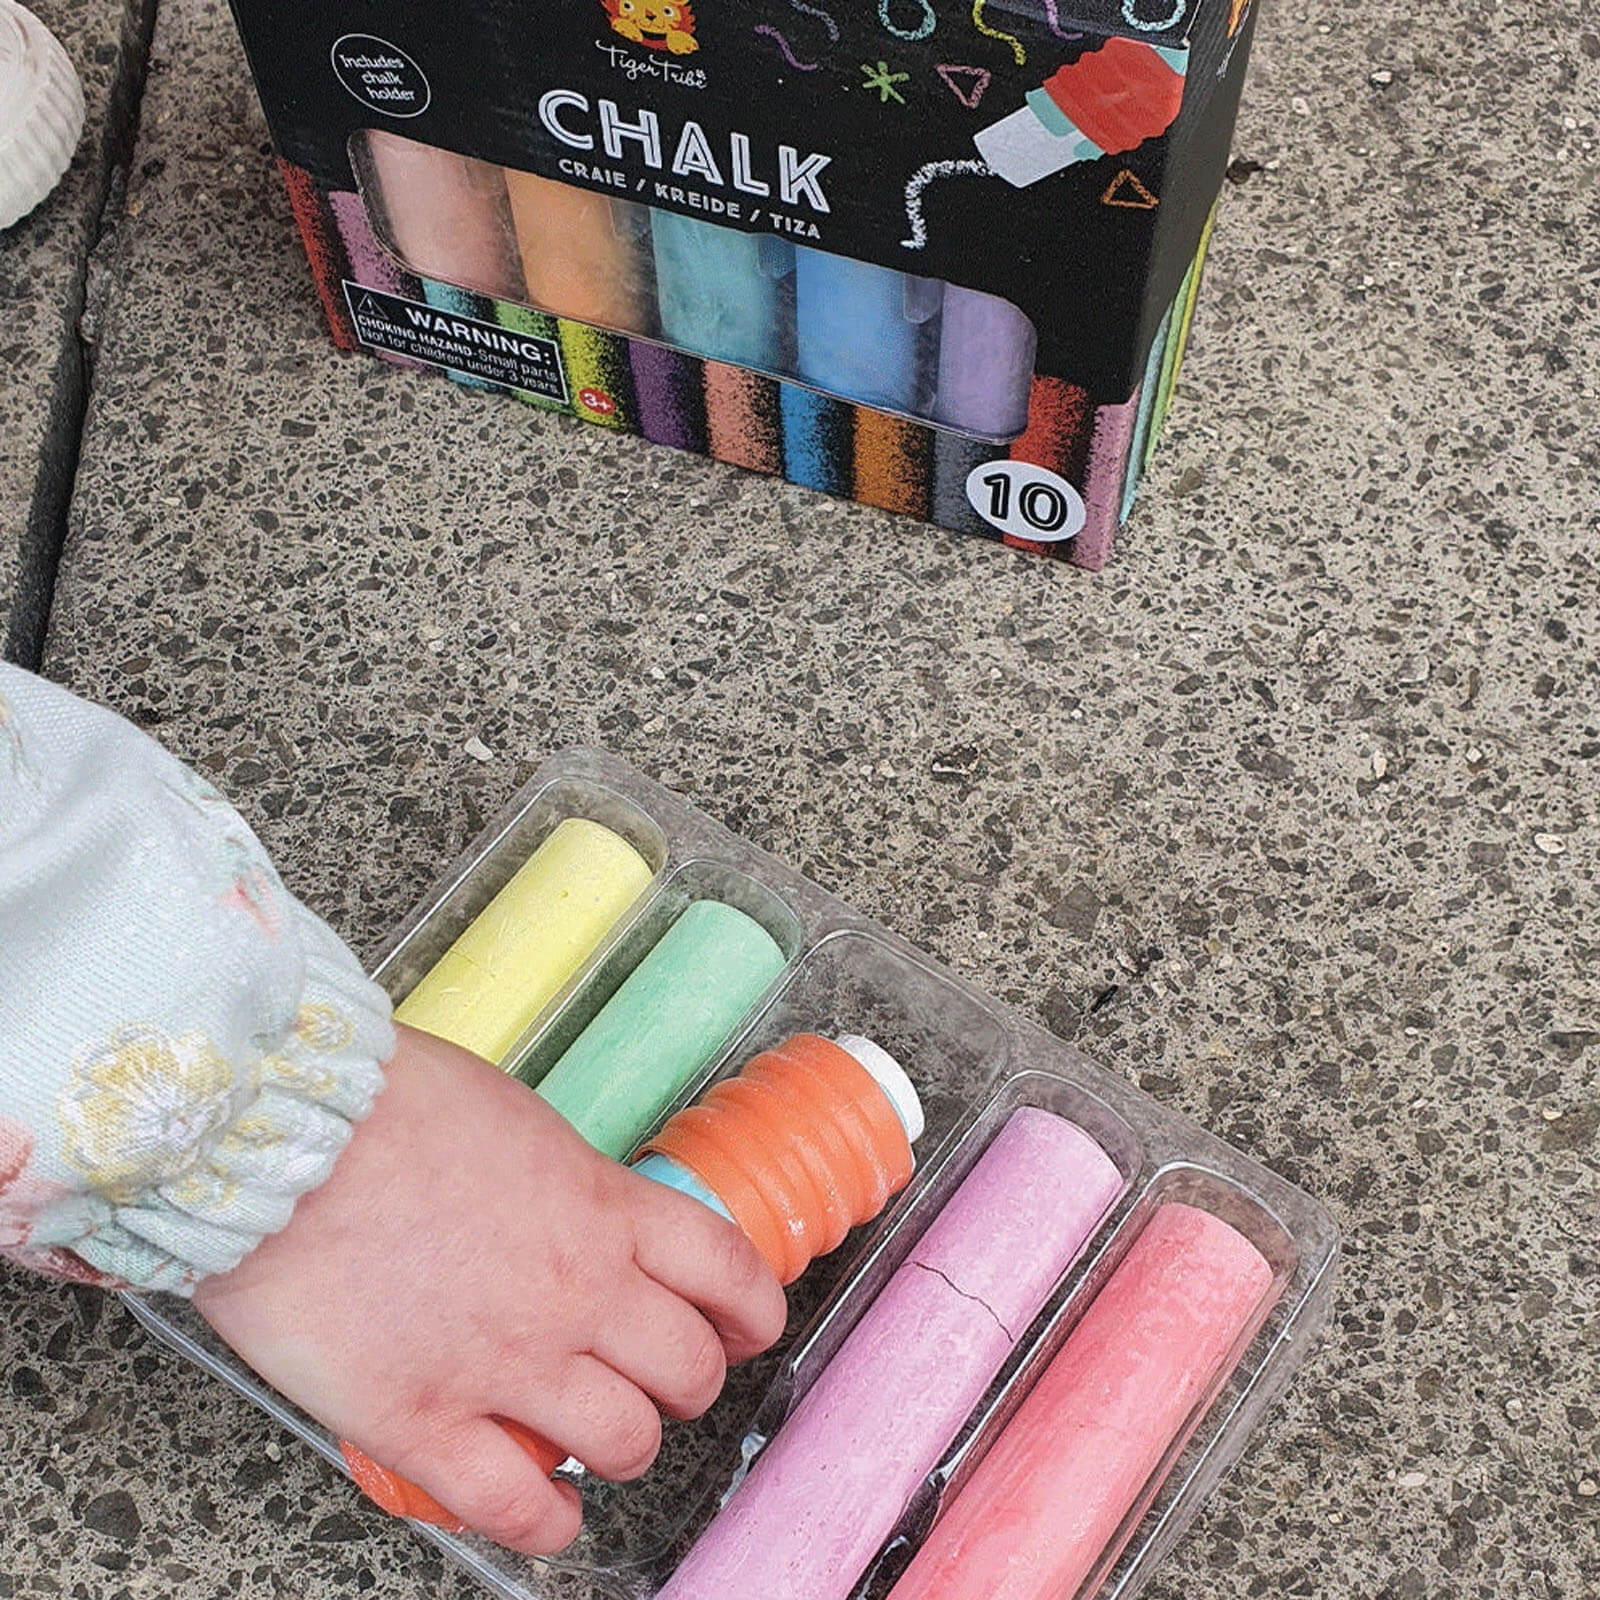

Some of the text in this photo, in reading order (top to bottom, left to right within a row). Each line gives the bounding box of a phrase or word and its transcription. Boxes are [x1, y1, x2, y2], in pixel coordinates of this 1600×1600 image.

[339, 54, 404, 69] Includes
[361, 70, 403, 85] chalk
[595, 40, 660, 80] Tiger
[366, 86, 415, 100] holder
[538, 90, 831, 213] CHALK
[558, 159, 627, 188] CRAIE
[655, 183, 741, 219] KREIDE
[769, 212, 821, 240] TIZA
[358, 315, 416, 340] CHOKING
[521, 363, 558, 382] parts
[361, 327, 385, 343] Not
[388, 335, 406, 348] for
[410, 343, 464, 366] children
[467, 359, 504, 378] under
[508, 369, 518, 382] 3
[405, 307, 551, 365] WARNING:
[584, 393, 612, 409] 3+
[983, 473, 1067, 532] 10
